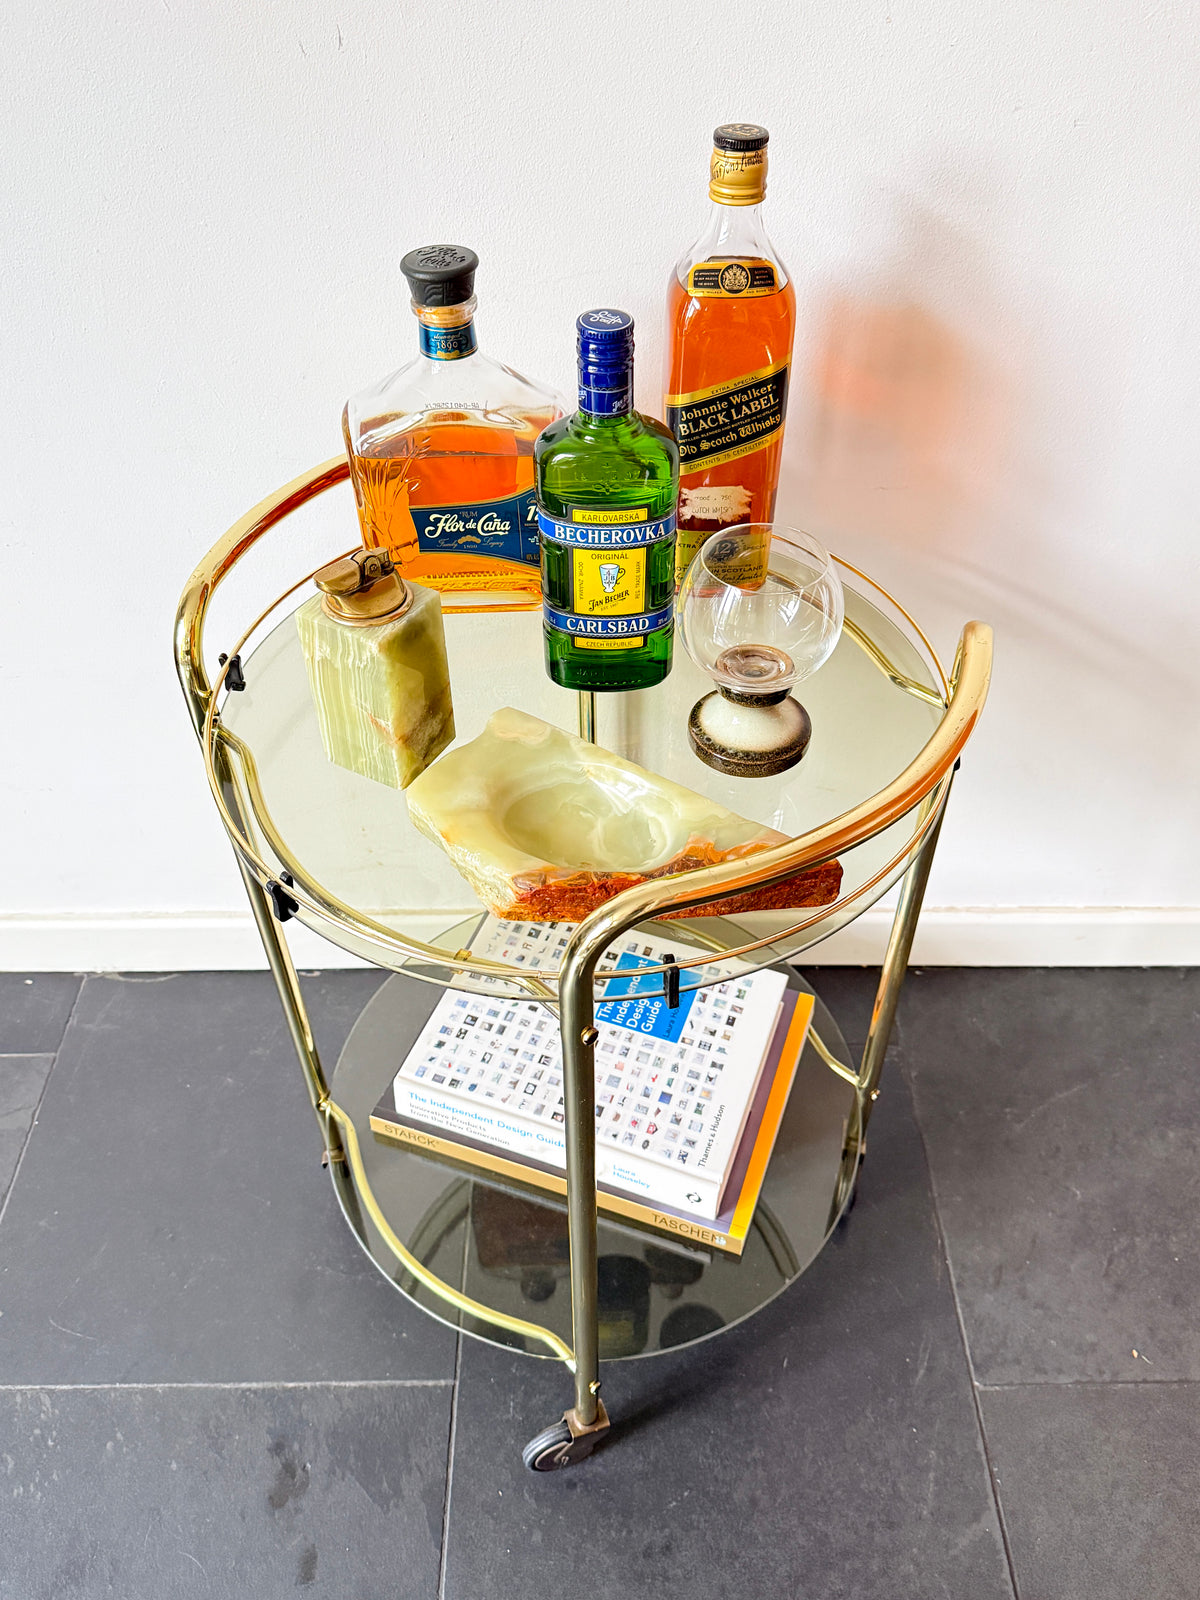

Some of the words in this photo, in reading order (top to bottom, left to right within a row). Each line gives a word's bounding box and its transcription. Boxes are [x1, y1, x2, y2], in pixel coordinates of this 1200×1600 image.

[437, 340, 458, 351] 1890
[711, 385, 730, 395] EXTRA
[733, 375, 759, 387] SPECIAL
[679, 411, 730, 436] BLACK
[730, 393, 779, 420] LABEL
[681, 401, 729, 421] Johnnie
[729, 383, 773, 405] Walker
[678, 445, 697, 457] Old
[700, 431, 737, 451] Scotch
[737, 413, 781, 438] Whisky
[689, 456, 721, 469] CONTENTS
[732, 439, 769, 455] CENTILITRES
[424, 513, 465, 538] Flor
[466, 519, 477, 529] de
[477, 512, 511, 536] Caña
[554, 523, 665, 544] BECHEROVKA
[721, 564, 763, 573] SCOTLAND
[566, 618, 649, 634] CARLSBAD
[597, 1001, 615, 1018] The
[626, 998, 652, 1029] Desig
[641, 1001, 662, 1033] Guide
[663, 1020, 676, 1038] Laura
[409, 1091, 427, 1104] The
[430, 1100, 494, 1125] Independent
[497, 1120, 533, 1139] Design
[409, 1102, 450, 1120] Innovative
[451, 1116, 487, 1132] Products
[410, 1109, 429, 1119] from
[430, 1114, 444, 1124] the
[445, 1119, 464, 1130] New
[465, 1125, 510, 1146] Generation
[384, 1124, 437, 1148] STARCK
[697, 1137, 715, 1168] Thames
[709, 1104, 726, 1133] Hudson
[612, 1170, 650, 1189] Houseley
[613, 1164, 636, 1176] Laura
